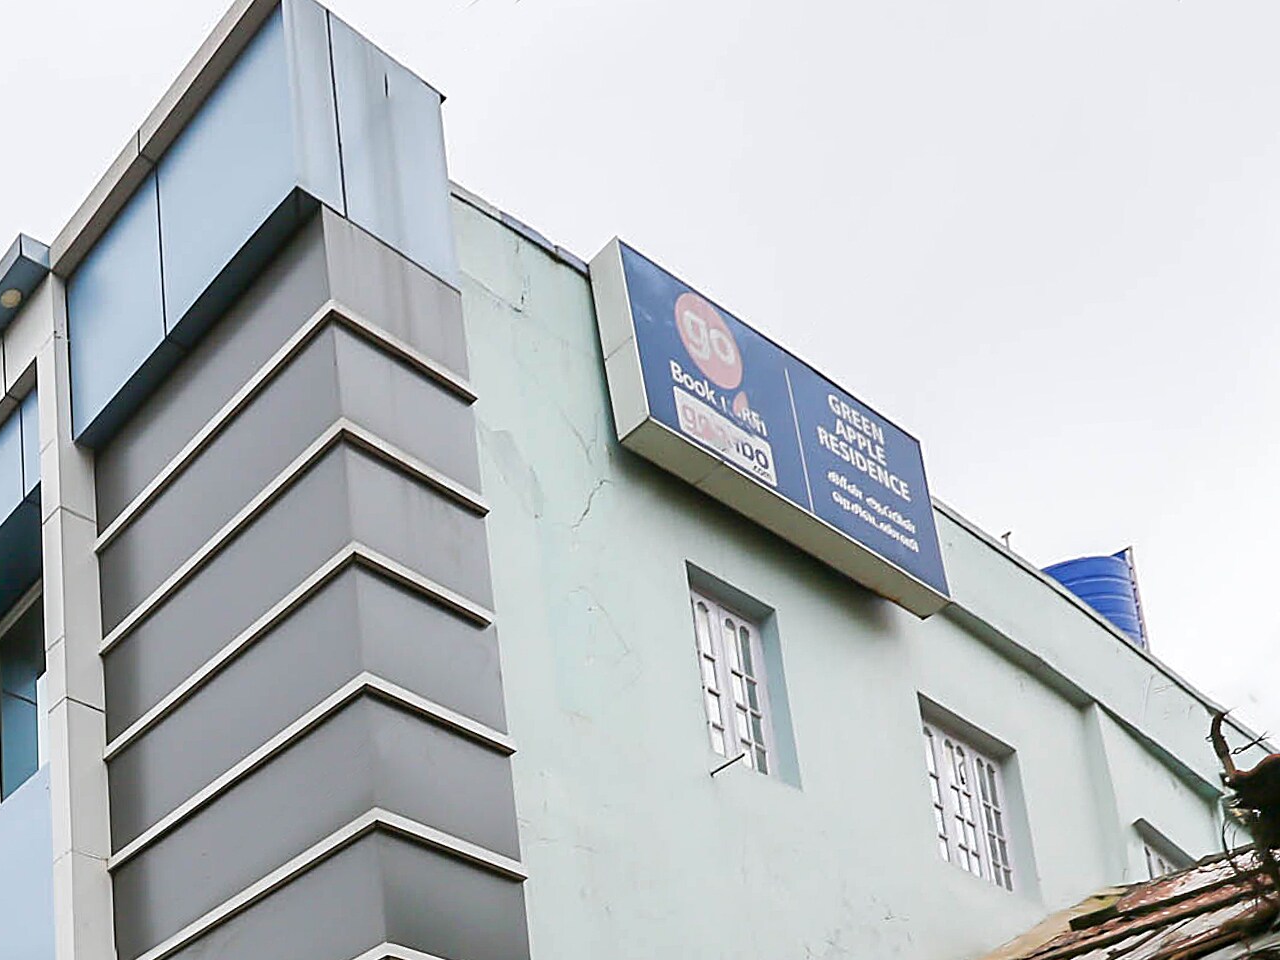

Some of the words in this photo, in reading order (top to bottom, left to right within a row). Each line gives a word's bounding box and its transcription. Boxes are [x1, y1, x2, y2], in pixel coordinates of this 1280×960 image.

[682, 309, 736, 366] go
[670, 359, 716, 404] Book
[828, 394, 884, 444] GREEN
[836, 418, 887, 466] APPLE
[816, 425, 912, 502] RESIDENCE
